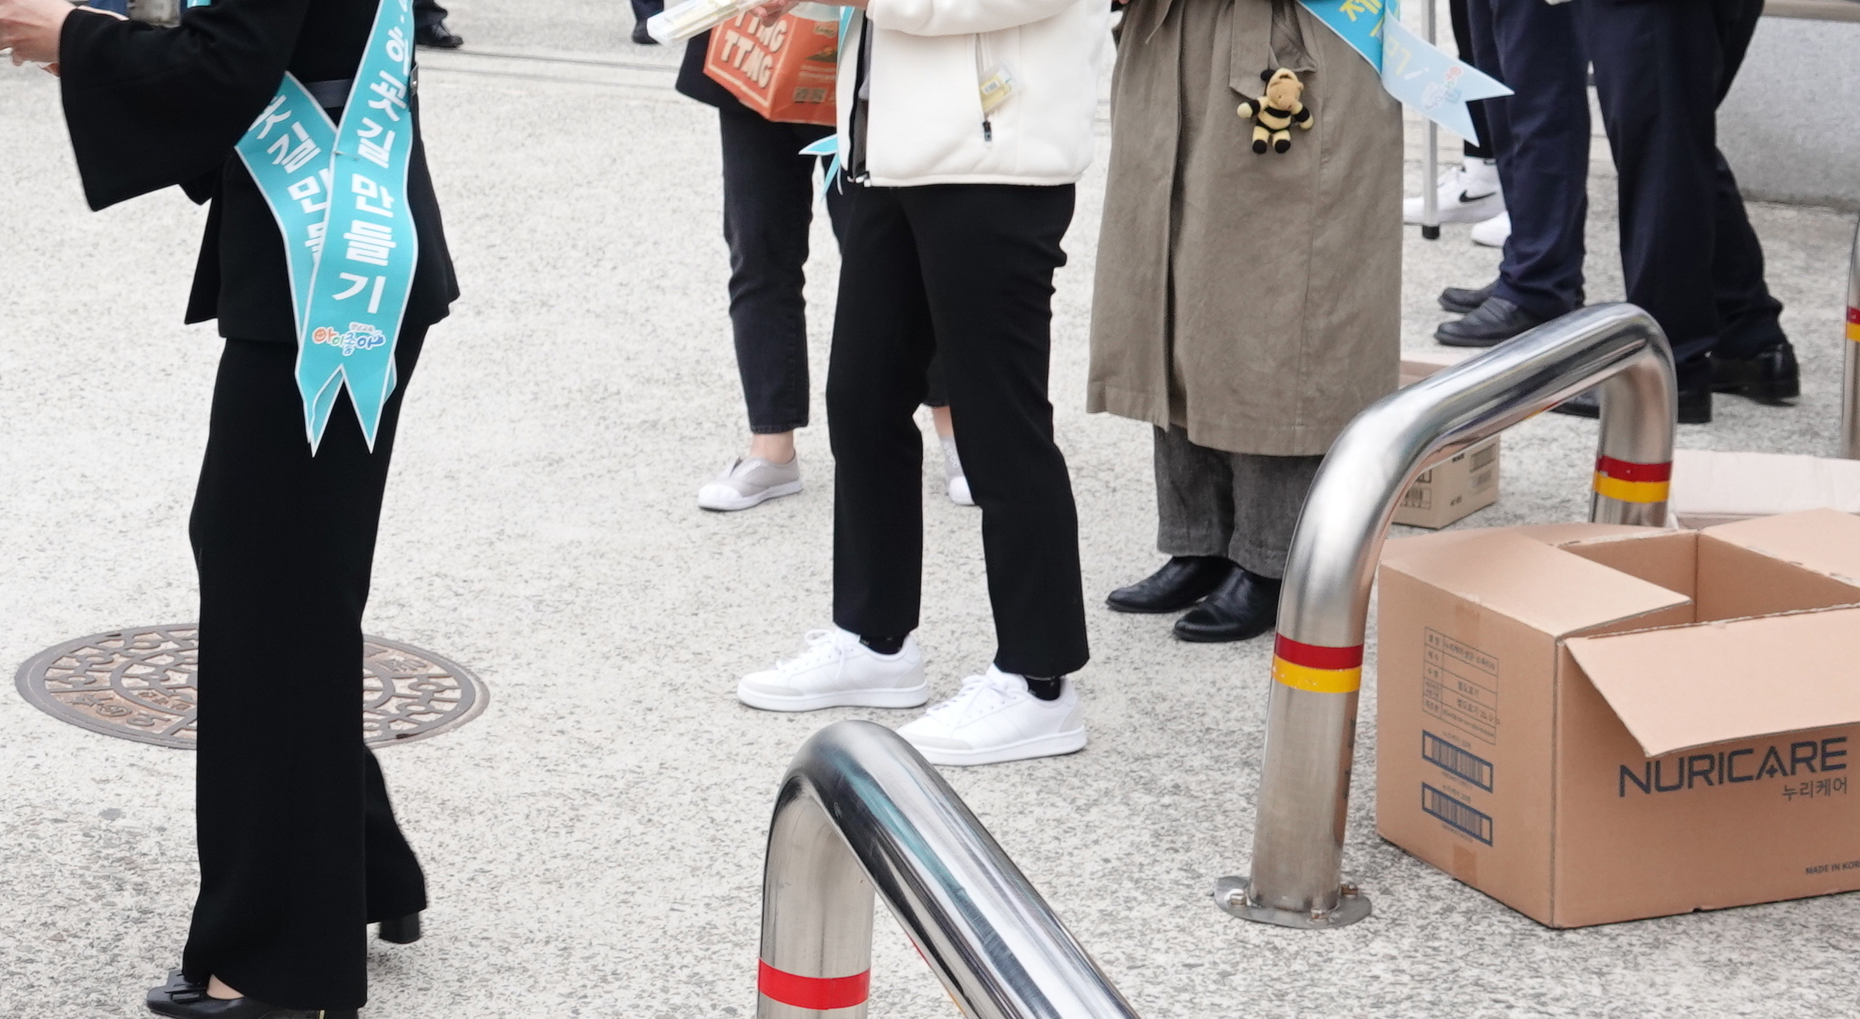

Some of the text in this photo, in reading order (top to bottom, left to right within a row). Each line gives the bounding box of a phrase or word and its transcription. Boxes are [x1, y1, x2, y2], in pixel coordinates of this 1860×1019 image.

[332, 173, 397, 315] 만들기
[1620, 737, 1848, 797] NURICARE
[1782, 777, 1848, 801] 누리케어
[1805, 863, 1829, 874] MADE
[1831, 862, 1841, 872] IN
